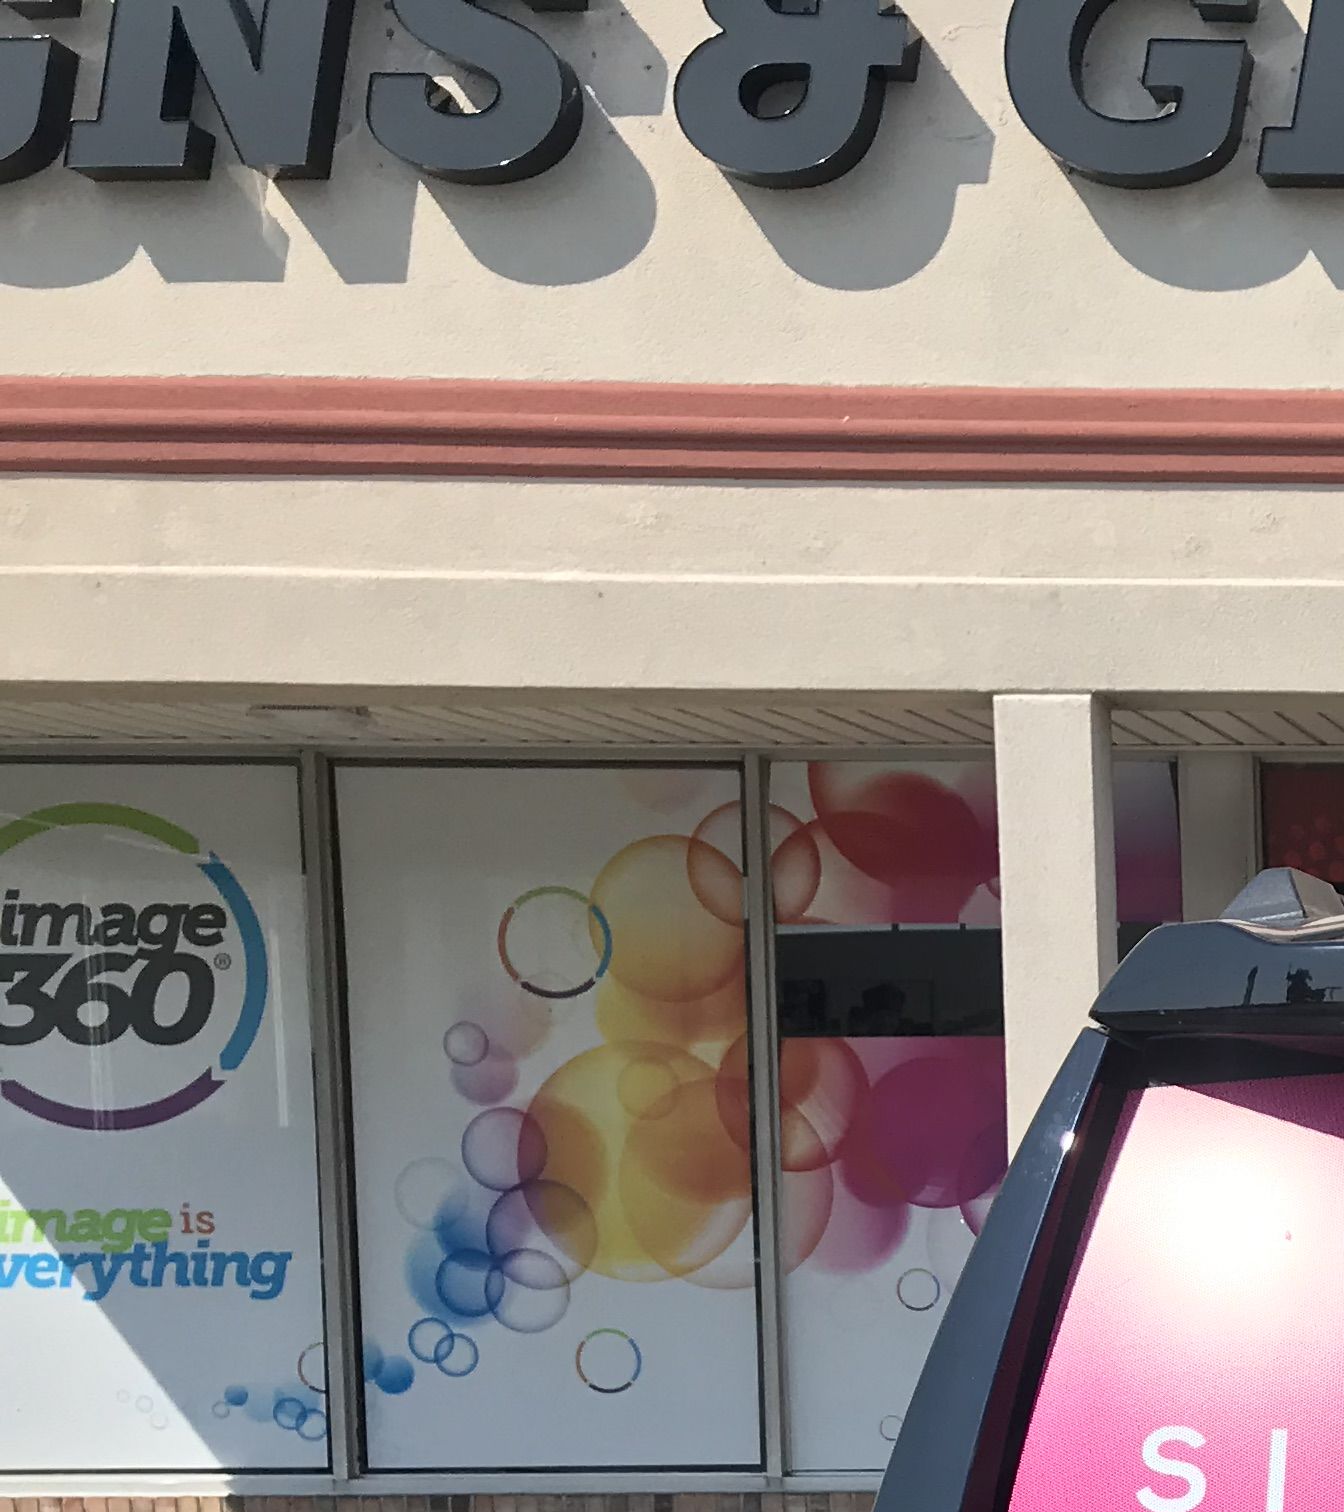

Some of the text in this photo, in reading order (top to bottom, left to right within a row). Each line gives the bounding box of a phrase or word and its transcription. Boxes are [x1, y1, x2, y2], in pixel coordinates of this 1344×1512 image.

[0, 888, 227, 959] image
[0, 952, 215, 1046] 360
[0, 1199, 216, 1254] image is
[0, 1239, 292, 1301] verything
